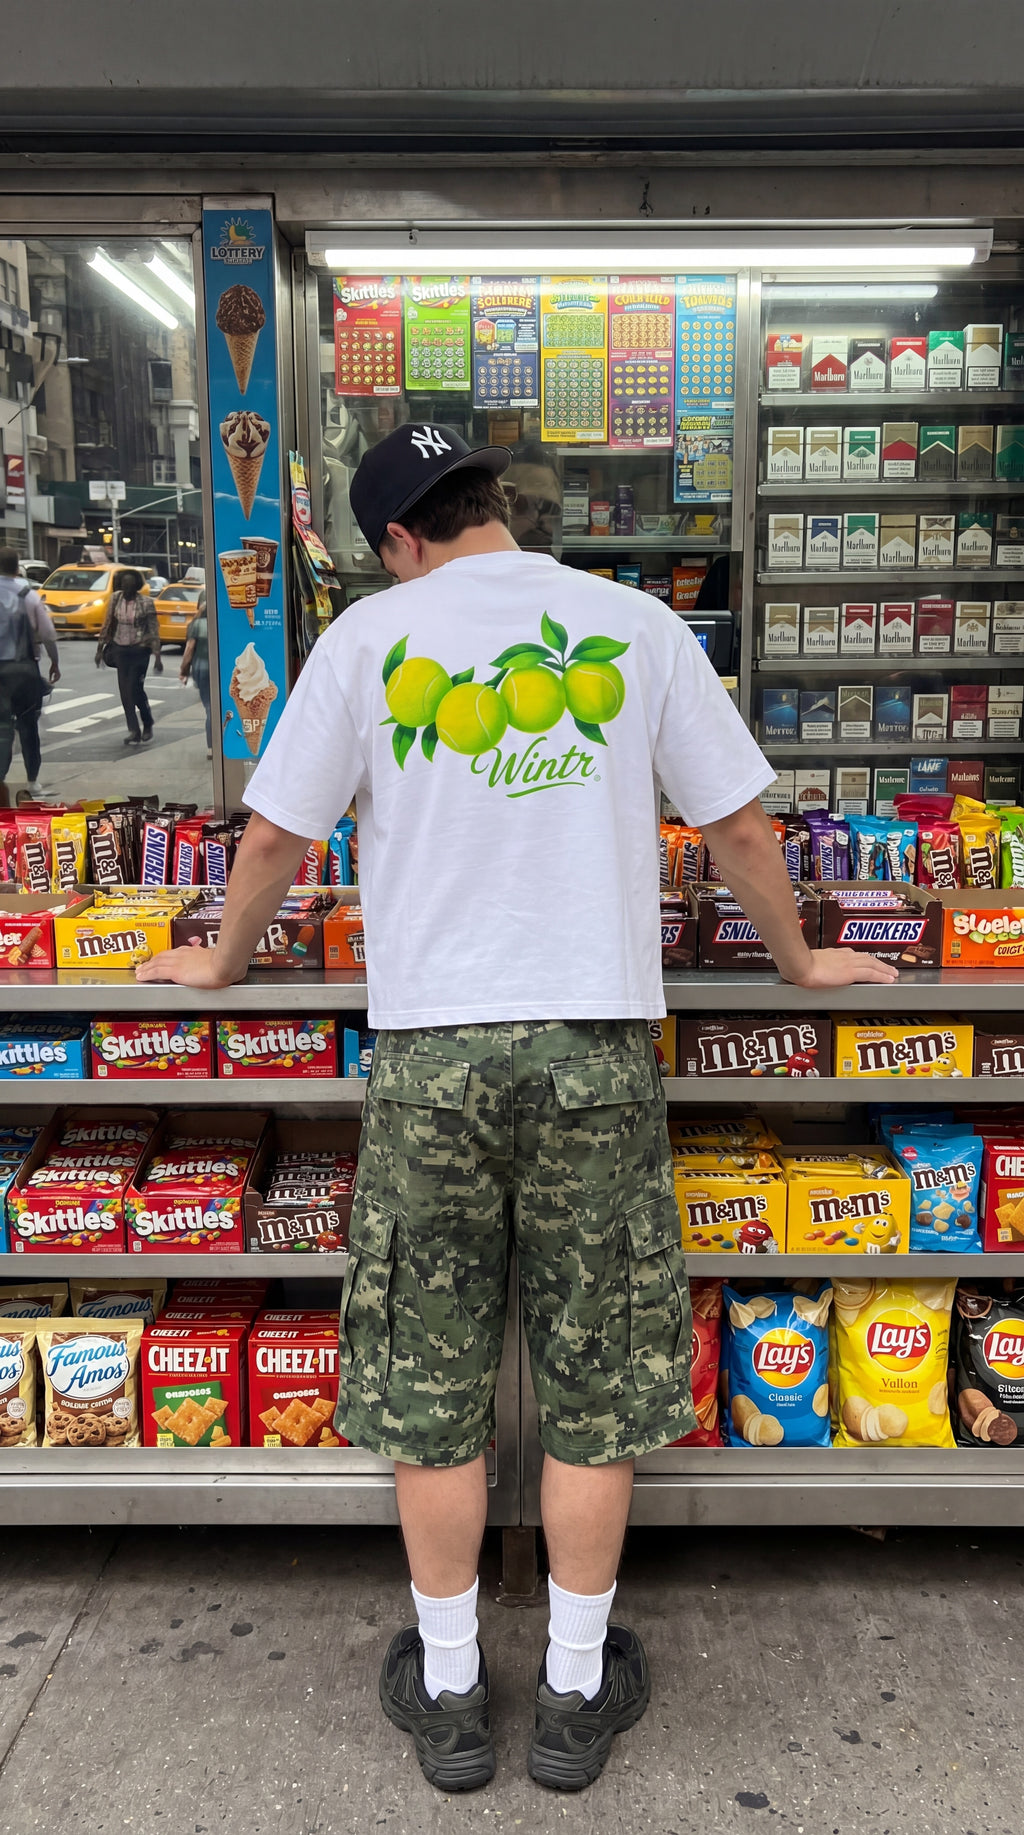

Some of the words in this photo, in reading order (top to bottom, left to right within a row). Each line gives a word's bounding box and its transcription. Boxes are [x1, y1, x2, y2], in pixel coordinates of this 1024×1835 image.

[212, 247, 264, 258] LOTTERY
[341, 282, 396, 304] Skittles
[412, 282, 466, 302] Skittles
[814, 368, 845, 381] Marlboro
[411, 426, 452, 458] NY
[470, 736, 597, 788] Wintr
[76, 930, 147, 958] m&m's
[719, 922, 759, 940] SNIC
[844, 922, 922, 940] SNICKERS
[0, 1043, 68, 1066] kittles
[101, 1030, 202, 1062] Skittles
[227, 1028, 327, 1059] Skittles
[699, 1025, 816, 1073] m&m's
[856, 1031, 956, 1073] m&m's
[61, 1126, 149, 1146] Skittles
[48, 1154, 136, 1168] Skittles
[148, 1160, 239, 1181] Skittles
[28, 1169, 122, 1186] Skittles
[912, 1163, 976, 1191] m&m's
[17, 1207, 116, 1237] Skittles
[135, 1206, 234, 1236] Skittles
[687, 1196, 767, 1228] m&m's
[810, 1191, 891, 1224] m&m's
[258, 1211, 340, 1244] m&m's
[78, 1297, 151, 1318] Famous
[871, 1324, 928, 1359] Lay's
[48, 1341, 128, 1376] Famous
[758, 1343, 811, 1375] Lay's
[61, 1362, 126, 1394] Amos
